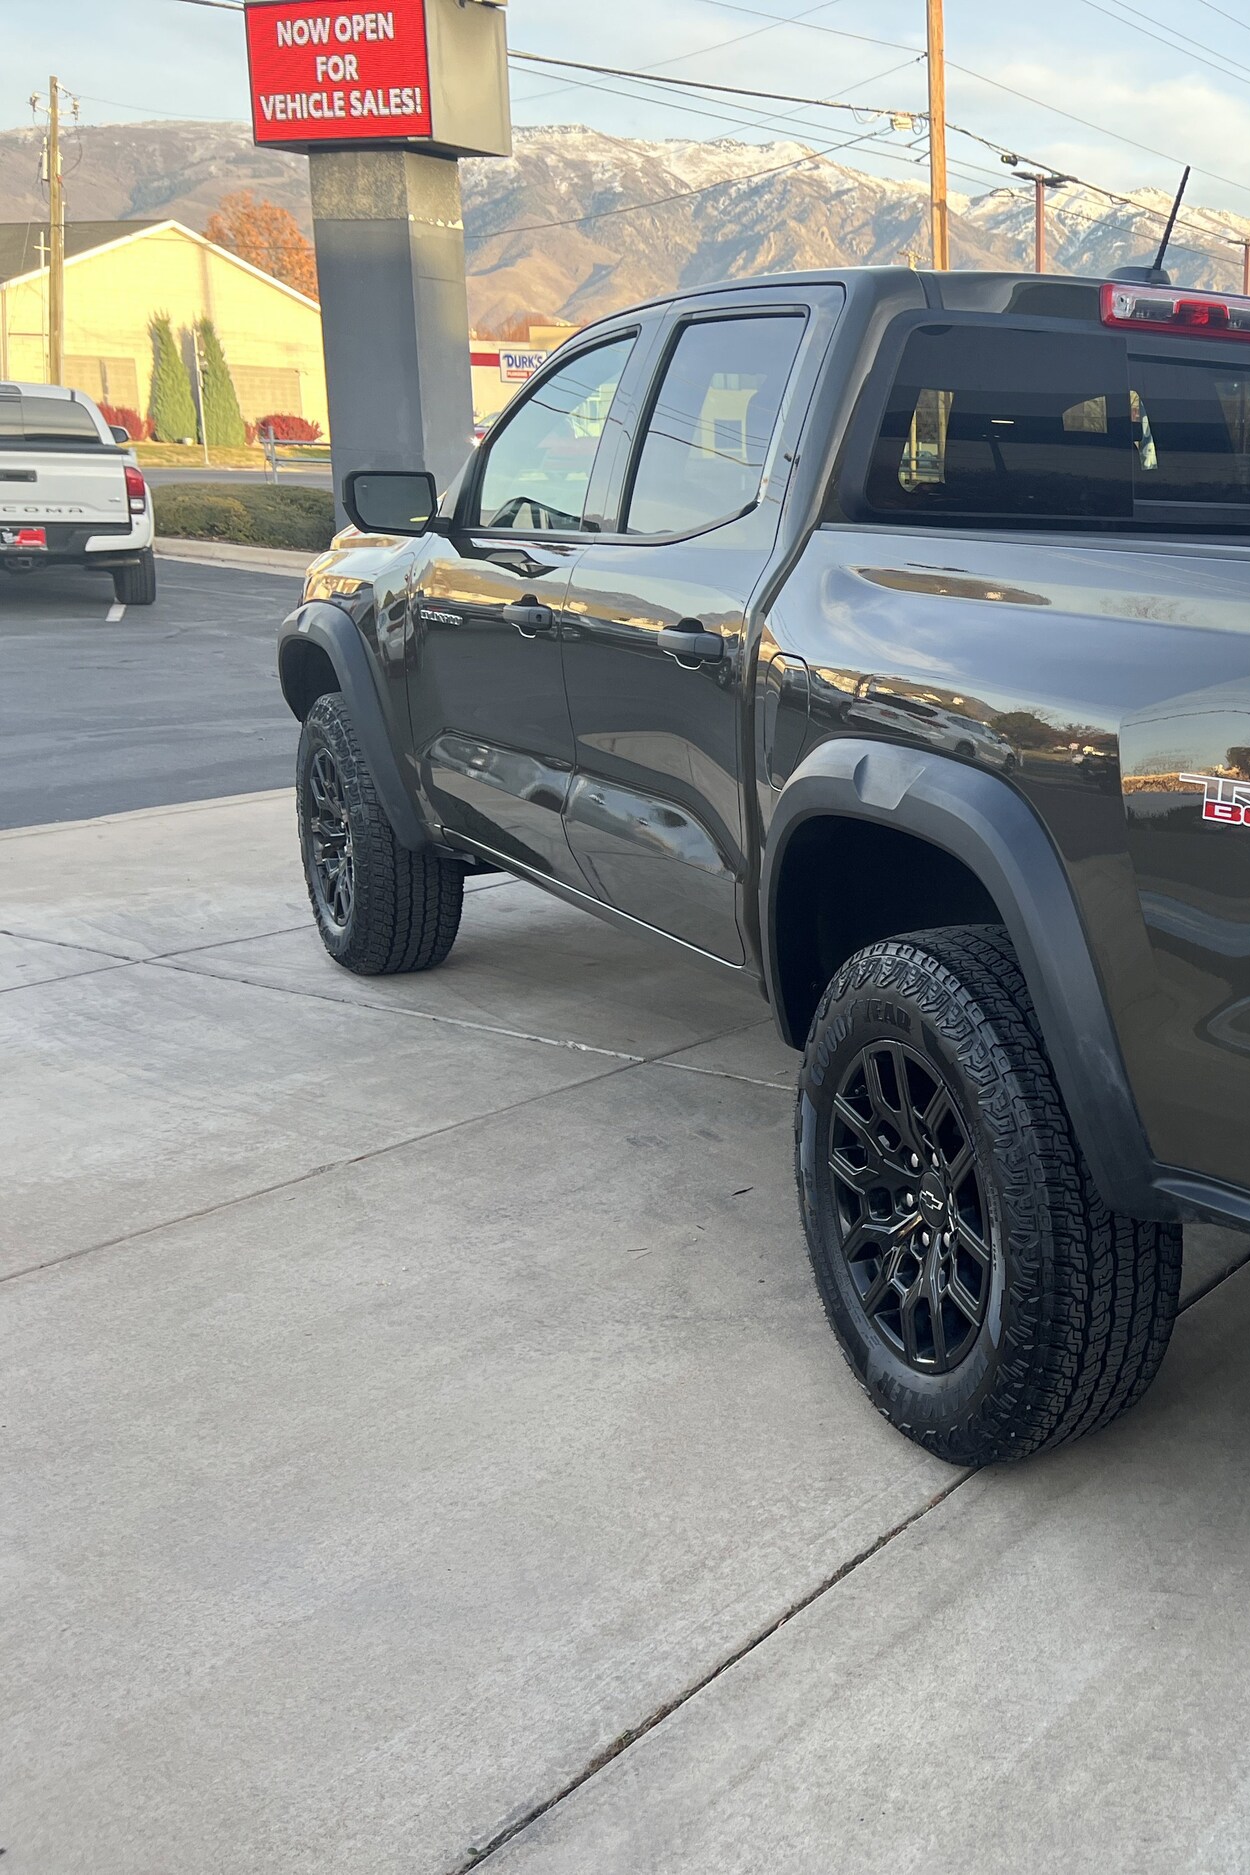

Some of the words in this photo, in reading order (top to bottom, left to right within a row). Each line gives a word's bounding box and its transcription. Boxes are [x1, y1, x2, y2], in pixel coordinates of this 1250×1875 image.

[276, 17, 330, 47] NOW
[334, 12, 395, 43] OPEN
[315, 54, 359, 83] FOR
[260, 90, 346, 121] VEHICLE
[349, 87, 422, 117] SALES!
